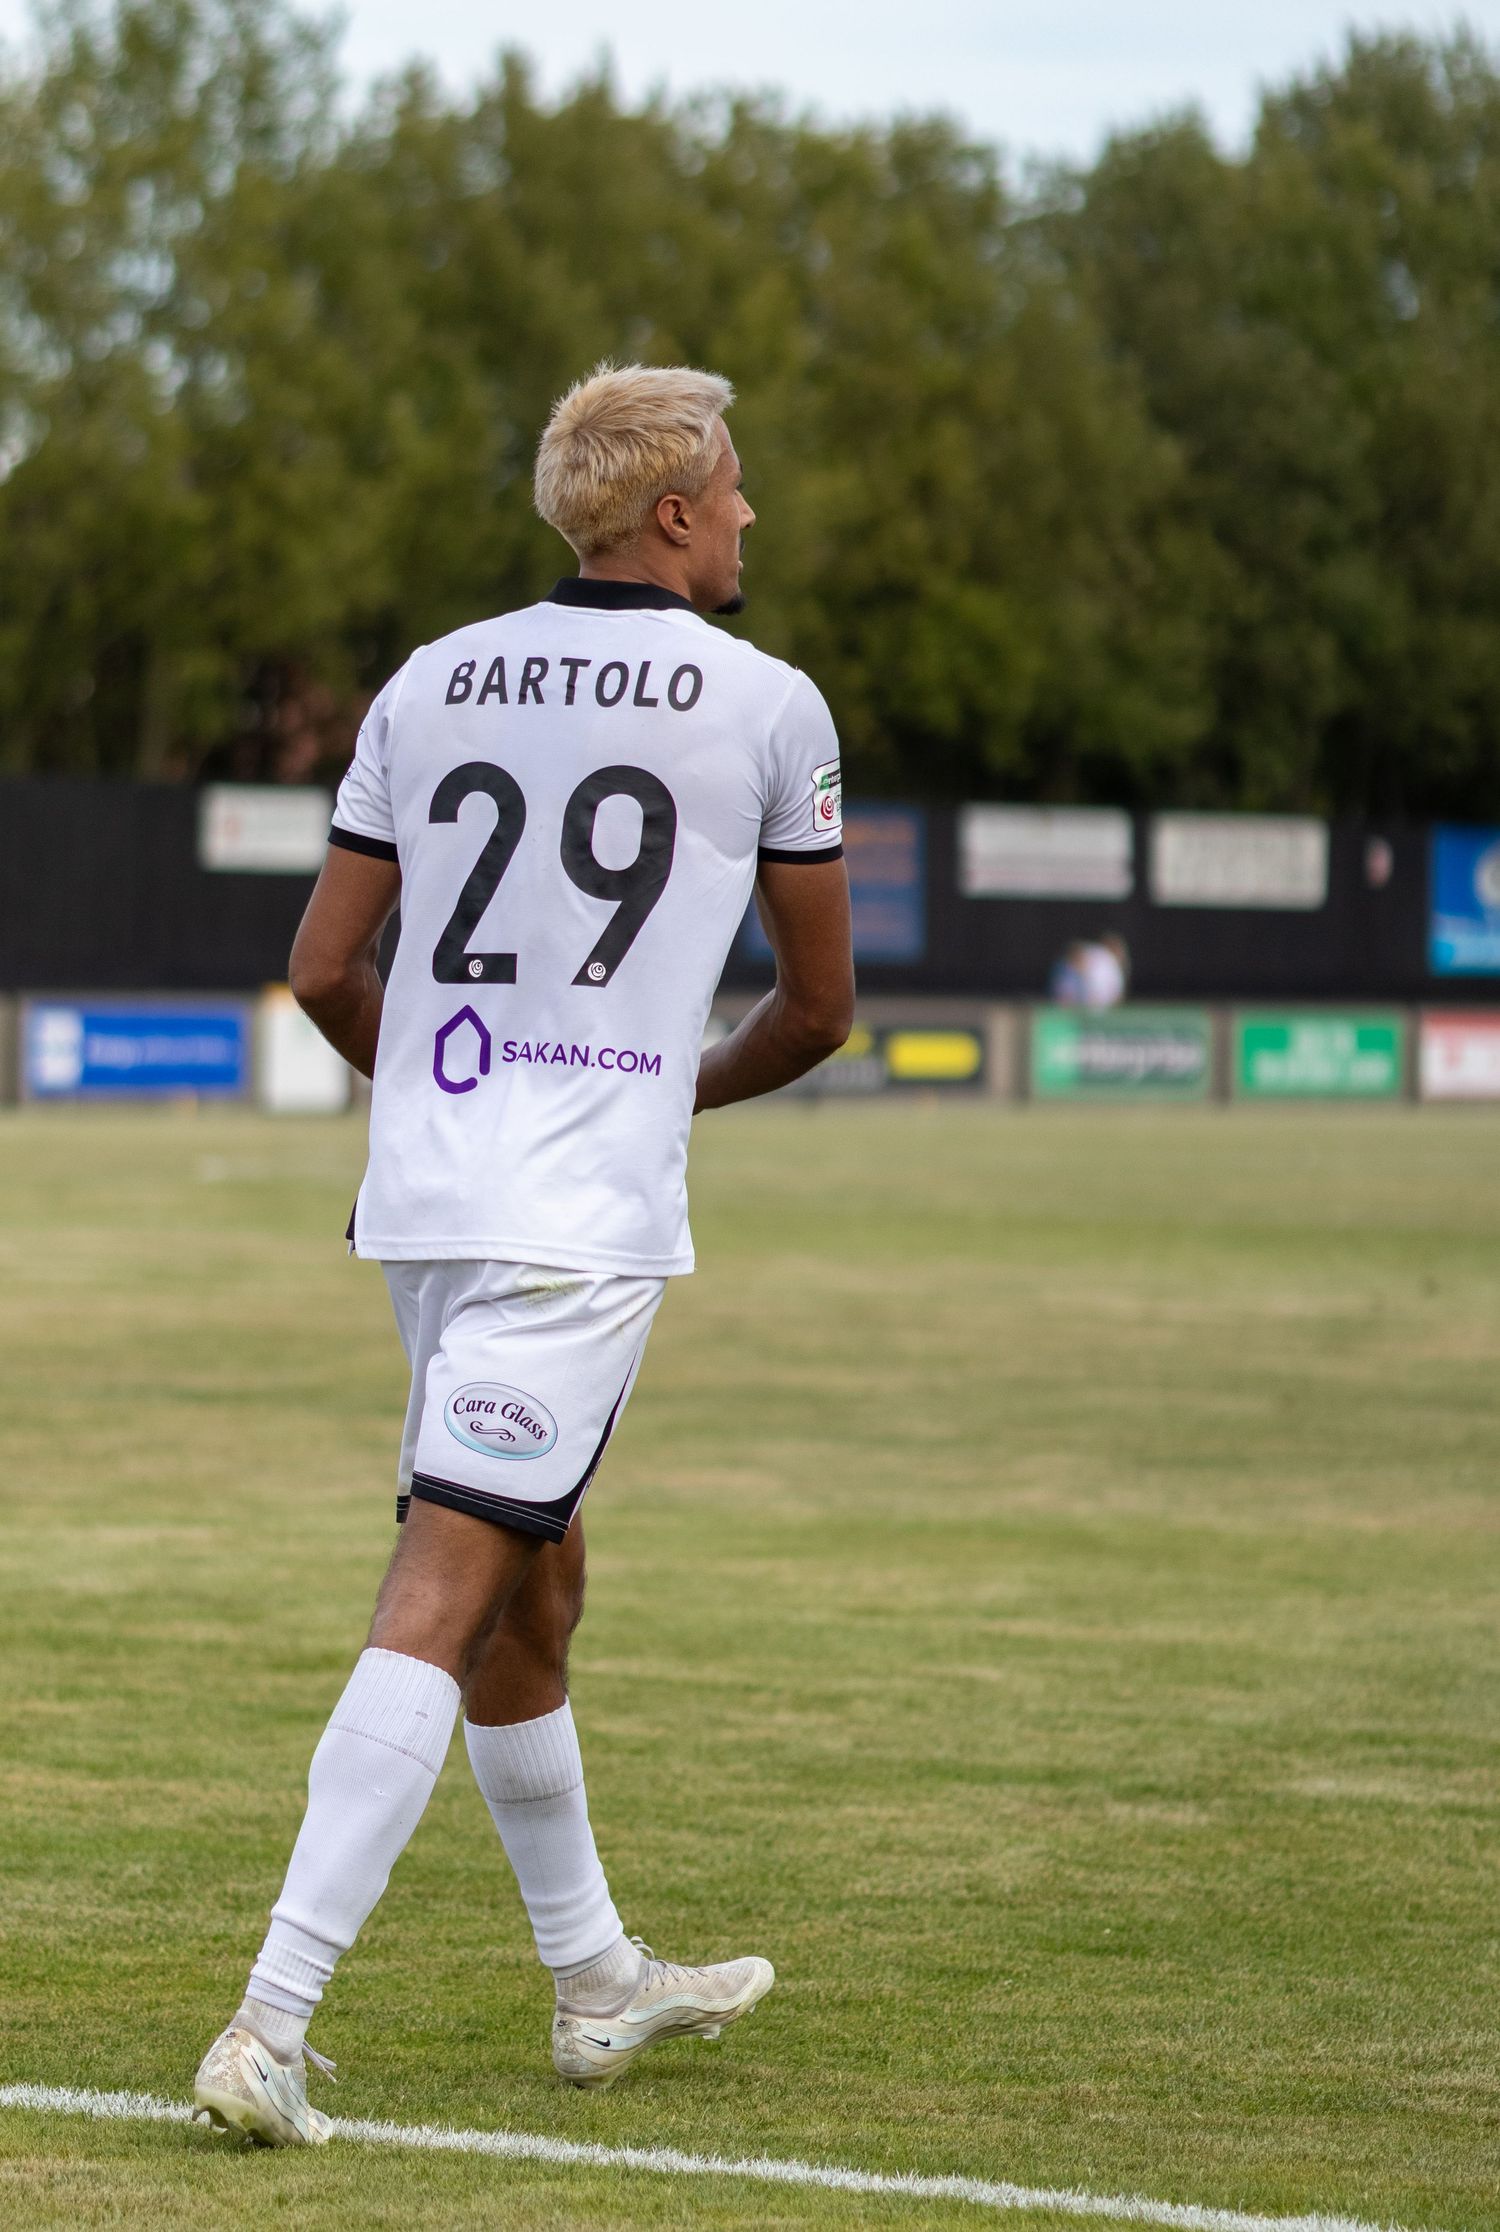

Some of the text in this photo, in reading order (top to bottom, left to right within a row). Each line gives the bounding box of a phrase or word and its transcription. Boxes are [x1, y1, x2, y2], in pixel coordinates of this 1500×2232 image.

[444, 655, 704, 712] BARTOLO
[428, 761, 678, 988] 29
[502, 1040, 662, 1077] SAKAN.COM
[452, 1397, 548, 1440] Cara Glass
